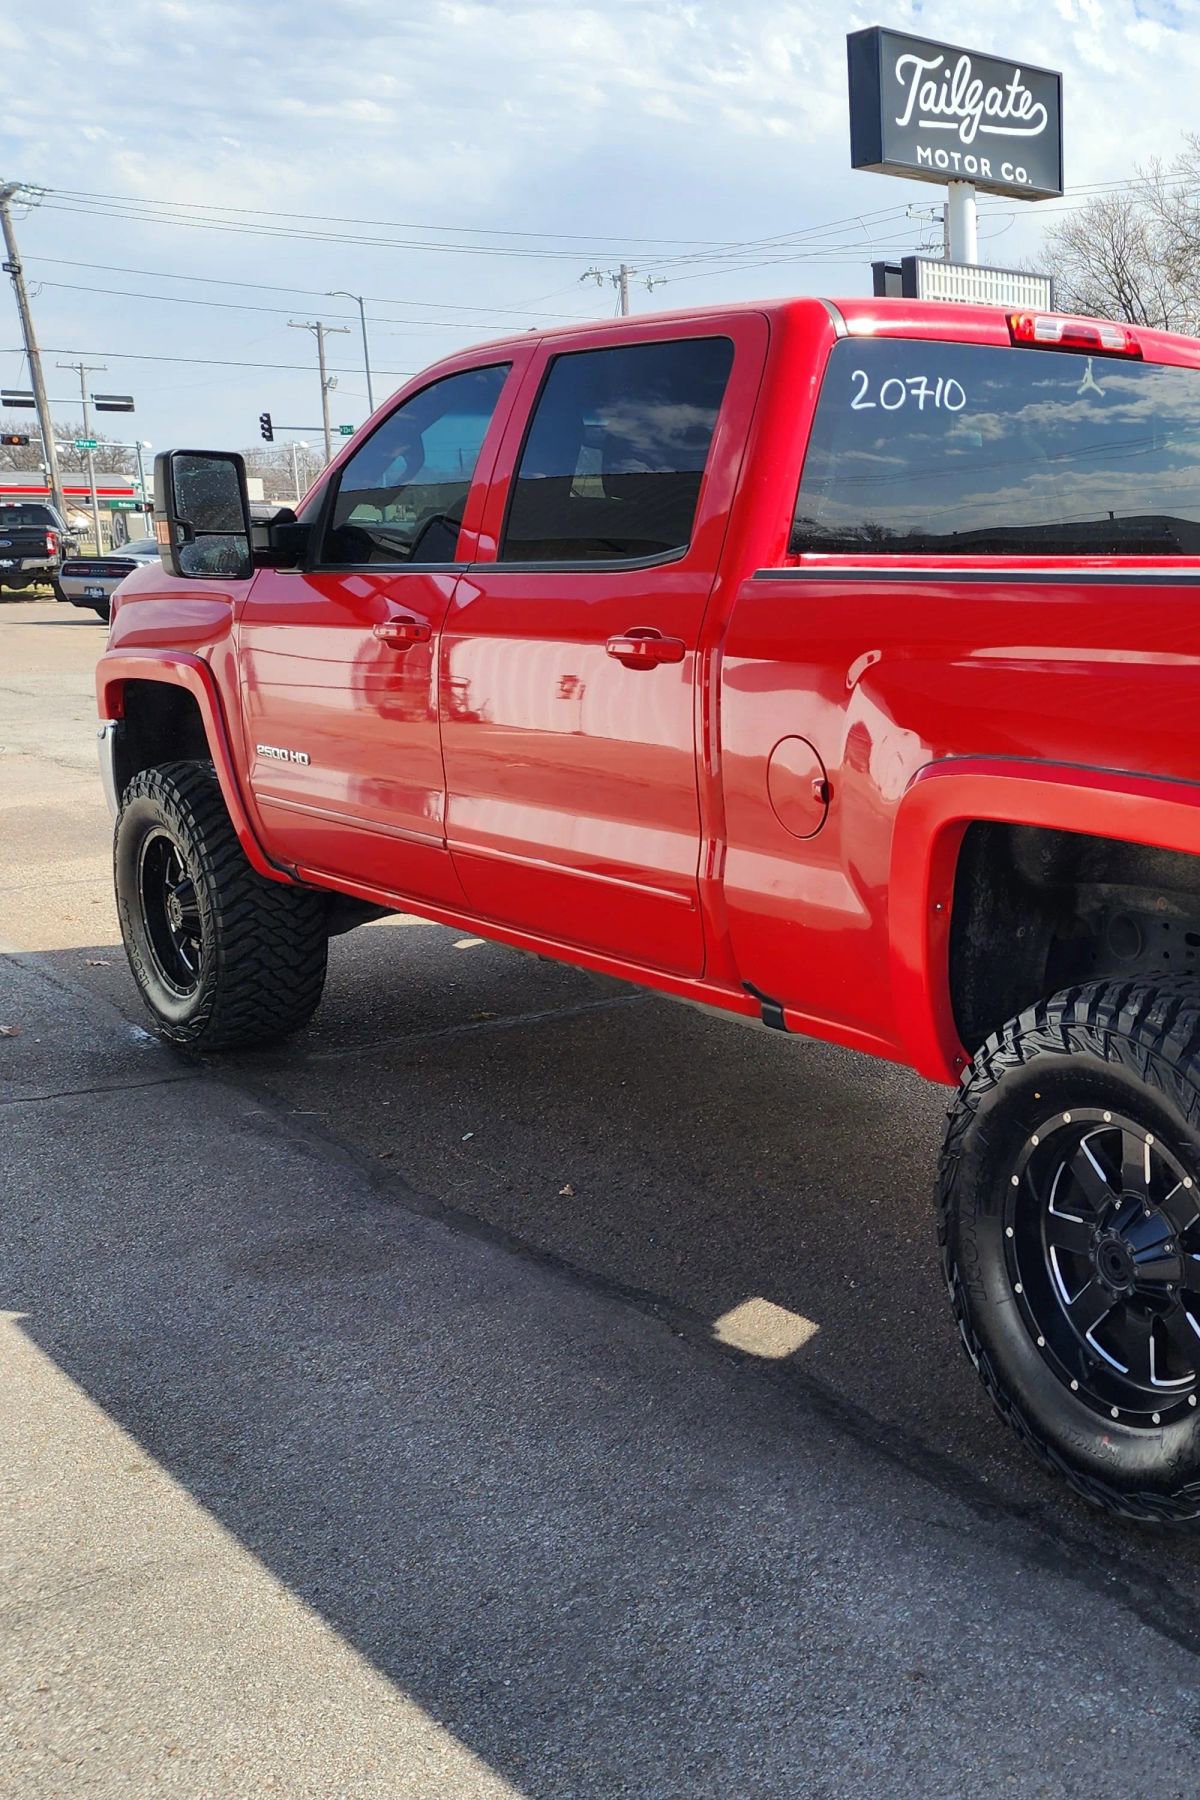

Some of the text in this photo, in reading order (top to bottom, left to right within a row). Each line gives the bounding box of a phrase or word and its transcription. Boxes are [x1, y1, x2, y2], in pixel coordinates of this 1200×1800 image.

[895, 53, 1048, 144] Tailgate
[916, 145, 1033, 185] MOTOR CO.
[850, 369, 967, 412] 20710
[256, 744, 311, 767] 2500 HD
